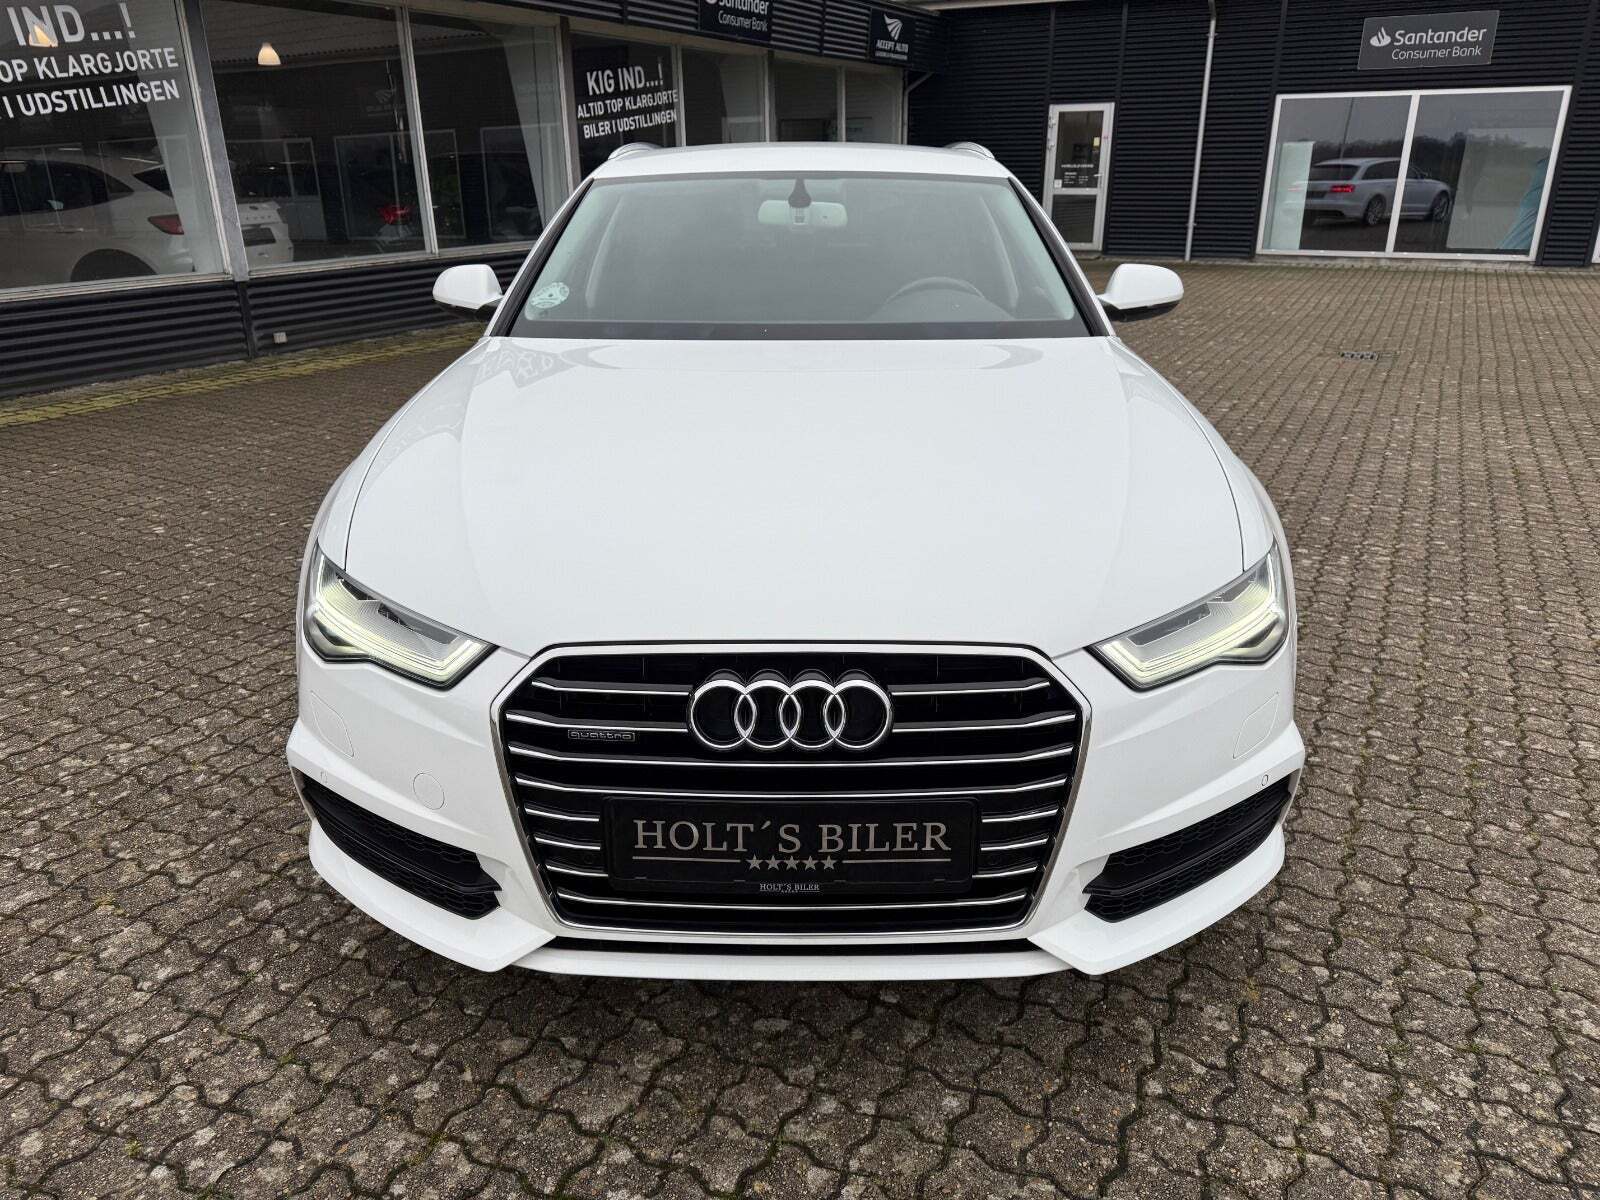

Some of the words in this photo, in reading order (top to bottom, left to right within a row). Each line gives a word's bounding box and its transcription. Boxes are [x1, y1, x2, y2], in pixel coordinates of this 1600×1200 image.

[718, 10, 752, 28] Consumer
[751, 16, 768, 32] Bank
[1393, 26, 1487, 46] Santander
[33, 47, 179, 80] KLARGJORTE
[1391, 49, 1450, 60] Consumer
[1452, 45, 1481, 57] Bank
[586, 70, 615, 96] KIG
[16, 79, 180, 116] UDSTILLINGEN
[577, 101, 604, 119] ALTID
[605, 98, 623, 114] TOP
[625, 90, 678, 110] KLARGJORTE
[583, 121, 611, 139] BILER
[611, 119, 616, 135] I
[617, 109, 678, 132] UDSTILLINGEN
[570, 731, 632, 740] quattro
[818, 822, 951, 853] BILER
[794, 883, 820, 891] BILER
